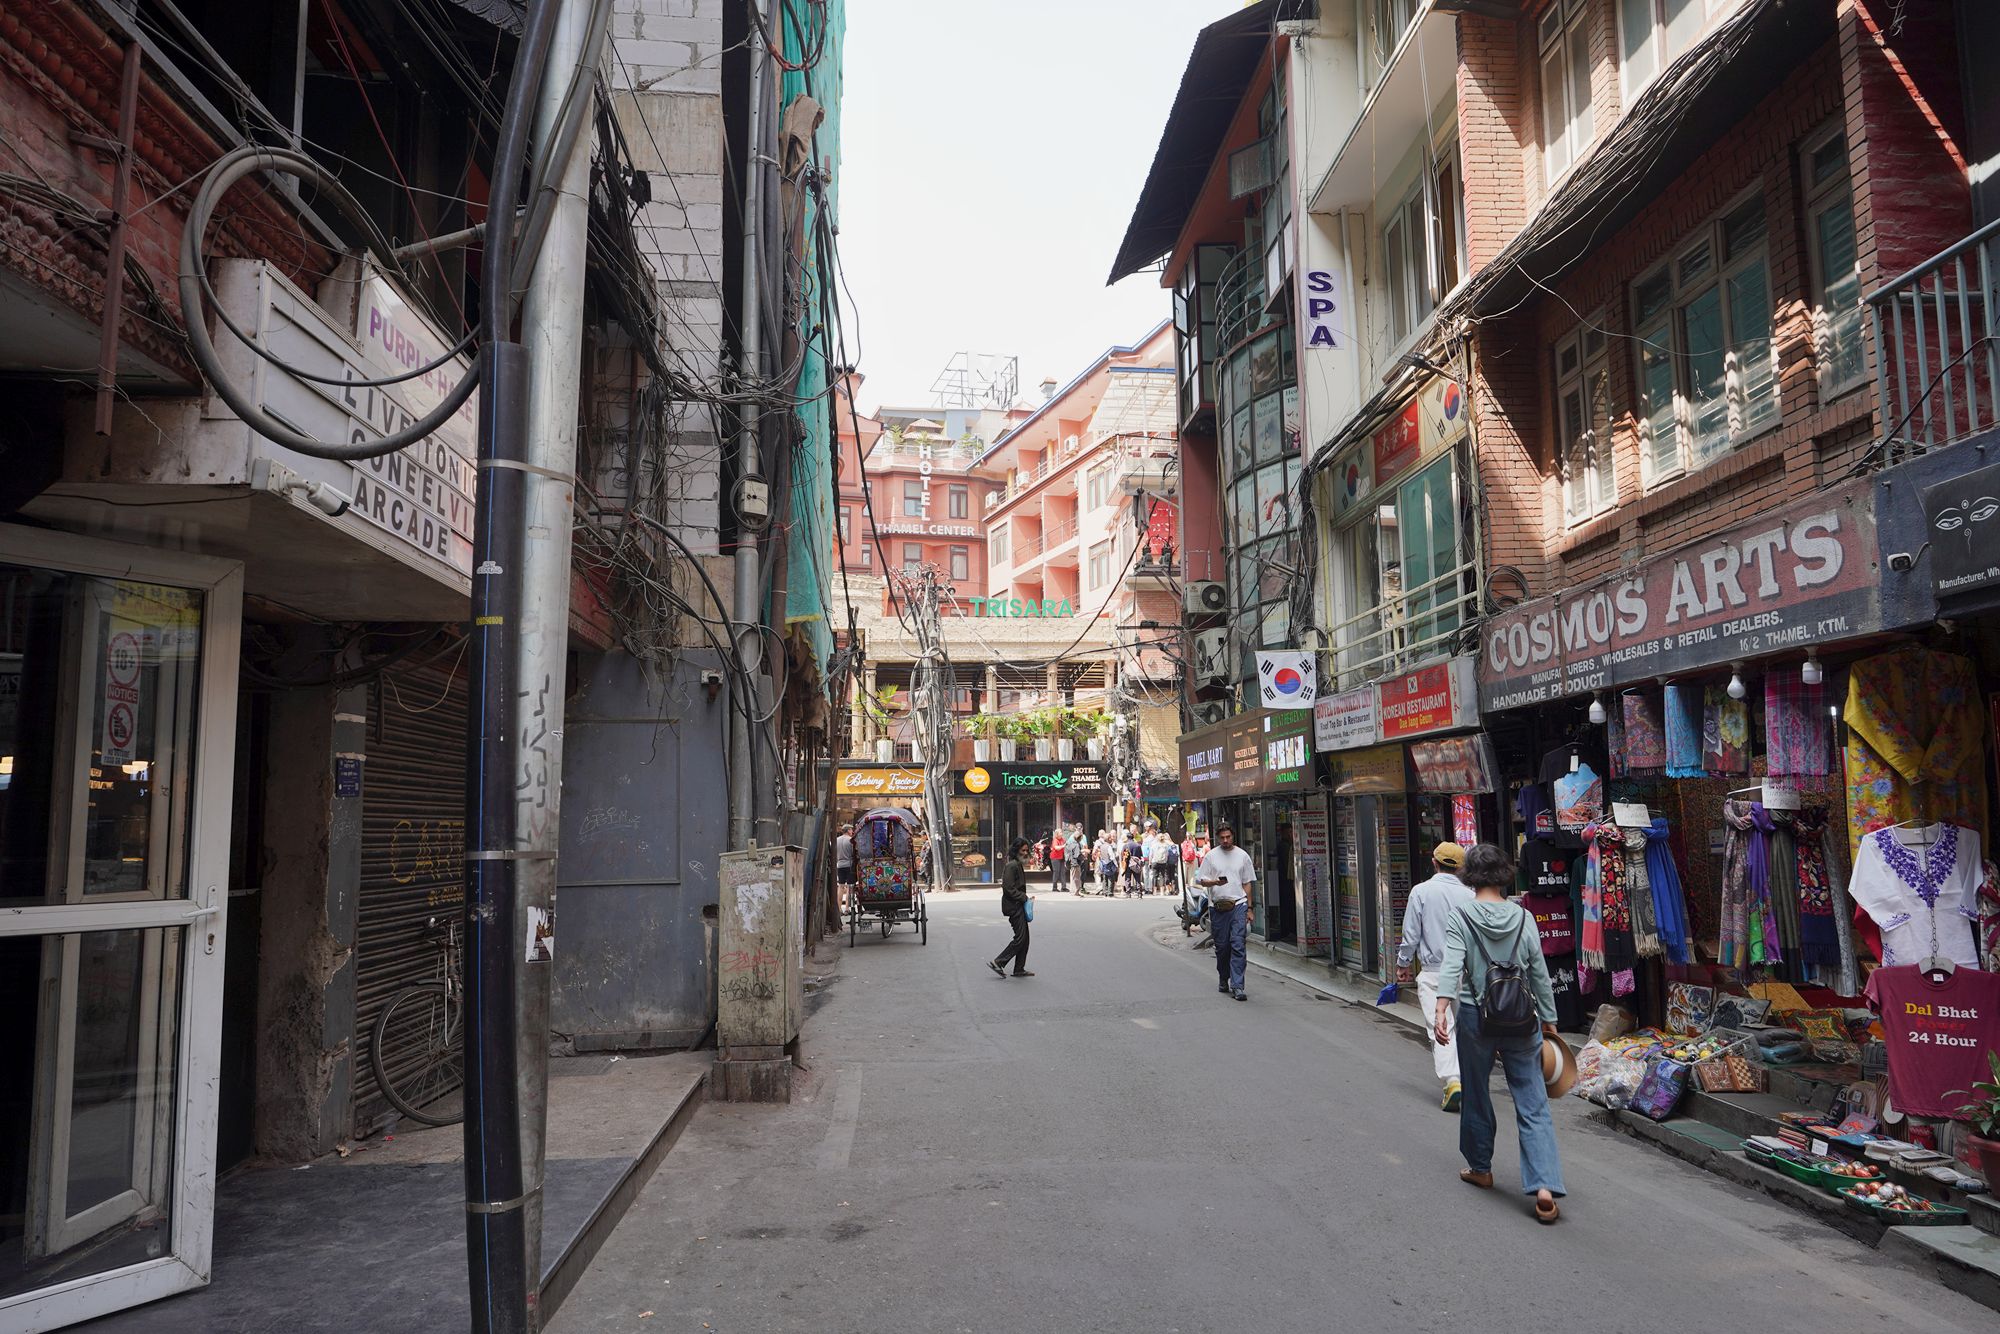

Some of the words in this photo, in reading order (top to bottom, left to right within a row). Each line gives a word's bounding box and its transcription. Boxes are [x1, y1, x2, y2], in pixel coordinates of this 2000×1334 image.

[1308, 271, 1337, 347] SPA
[369, 306, 433, 390] PURPLE
[438, 370, 473, 424] HE
[919, 445, 932, 521] HOTEL
[353, 477, 448, 557] ARCADE
[876, 524, 927, 535] THAMEL
[929, 524, 975, 536] CENTER
[1939, 569, 1986, 589] Manufacturer,
[1489, 577, 1648, 673] COSMOS
[1665, 508, 1843, 623] ARTS
[969, 598, 1074, 618] TRISARA
[1818, 616, 1848, 635] KTM.
[1602, 641, 1659, 667] WHOLESALES
[1664, 637, 1673, 650] &
[1678, 627, 1717, 647] RETAIL
[1723, 611, 1783, 637] DEALERS.
[114, 649, 135, 671] 18+
[107, 685, 138, 702] NOTICE
[1493, 688, 1546, 709] HANDMADE
[1382, 702, 1406, 720] KOREAN
[1407, 692, 1447, 715] RESTAURANT
[1348, 713, 1370, 725] Restaurant
[1187, 749, 1207, 770] THAMEL
[1207, 746, 1223, 766] MART
[845, 772, 885, 789] Baking
[889, 772, 921, 789] Factory
[1002, 772, 1048, 786] Trisara
[1209, 768, 1220, 780] Store
[1275, 770, 1299, 784] ENTRANCE
[1542, 861, 1548, 872] I
[1536, 914, 1549, 922] Dal
[1551, 913, 1568, 921] Bha
[1540, 930, 1549, 938] 24
[1905, 1002, 1932, 1015] Dal
[1937, 1005, 1978, 1019] Bhat
[1916, 1018, 1967, 1030] Power
[1908, 1031, 1930, 1043] 24
[1935, 1033, 1978, 1047] Hour
